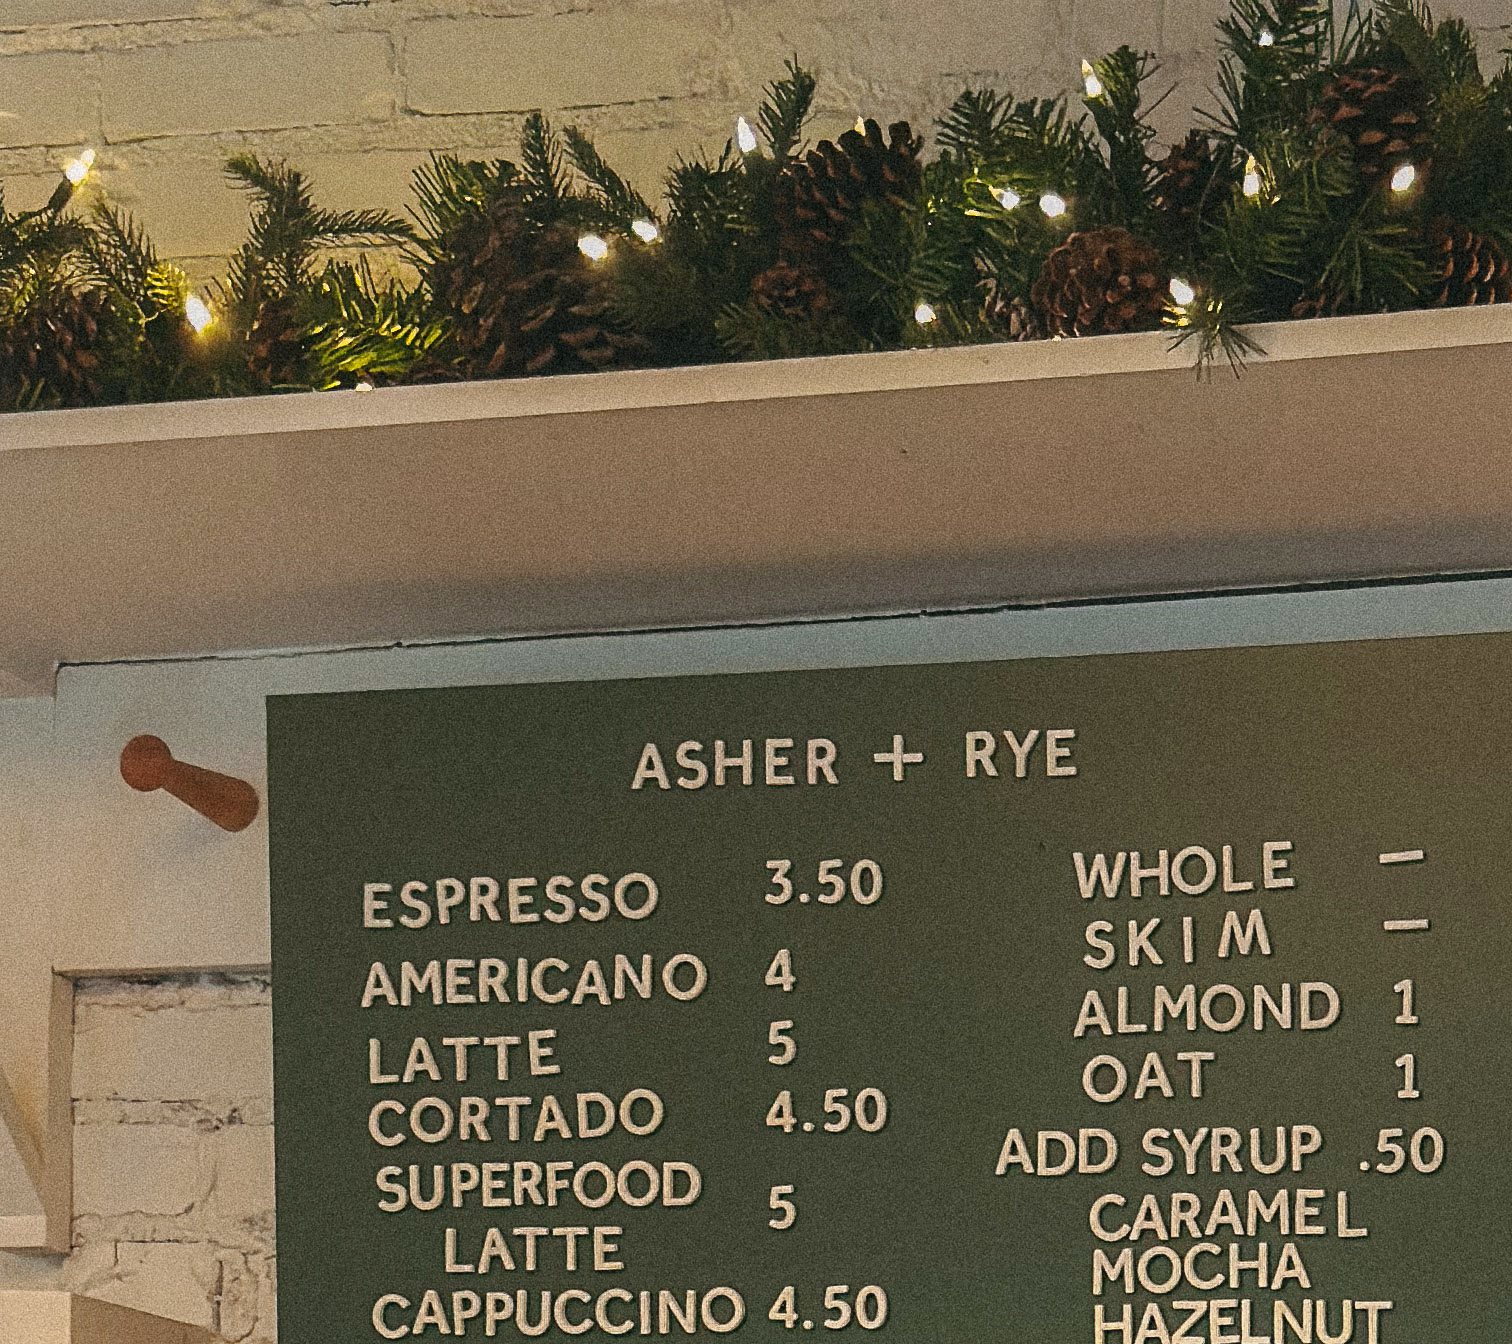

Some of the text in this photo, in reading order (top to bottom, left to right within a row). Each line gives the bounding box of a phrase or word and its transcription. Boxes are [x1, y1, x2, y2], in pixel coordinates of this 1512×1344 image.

[630, 737, 840, 791] ASHER
[964, 727, 1078, 779] RYE
[362, 857, 884, 929] ESPRESSO 3.50
[1071, 839, 1296, 900] WHOLE
[360, 947, 797, 1009] AMERICANO 4
[1072, 977, 1419, 1039] ALMOND 1
[368, 1018, 797, 1085] LATTE 5
[1081, 1050, 1421, 1104] OAT 1
[367, 1086, 888, 1148] CORTADO 4.50
[994, 1123, 1445, 1177] ADD SYRUP .50
[374, 1159, 797, 1231] SUPERFOOD 5
[1088, 1187, 1369, 1243] CARAMEL
[444, 1224, 625, 1275] LATTE
[1091, 1240, 1312, 1297] MOCHA
[371, 1283, 888, 1340] CAPPUCCINO 4.50
